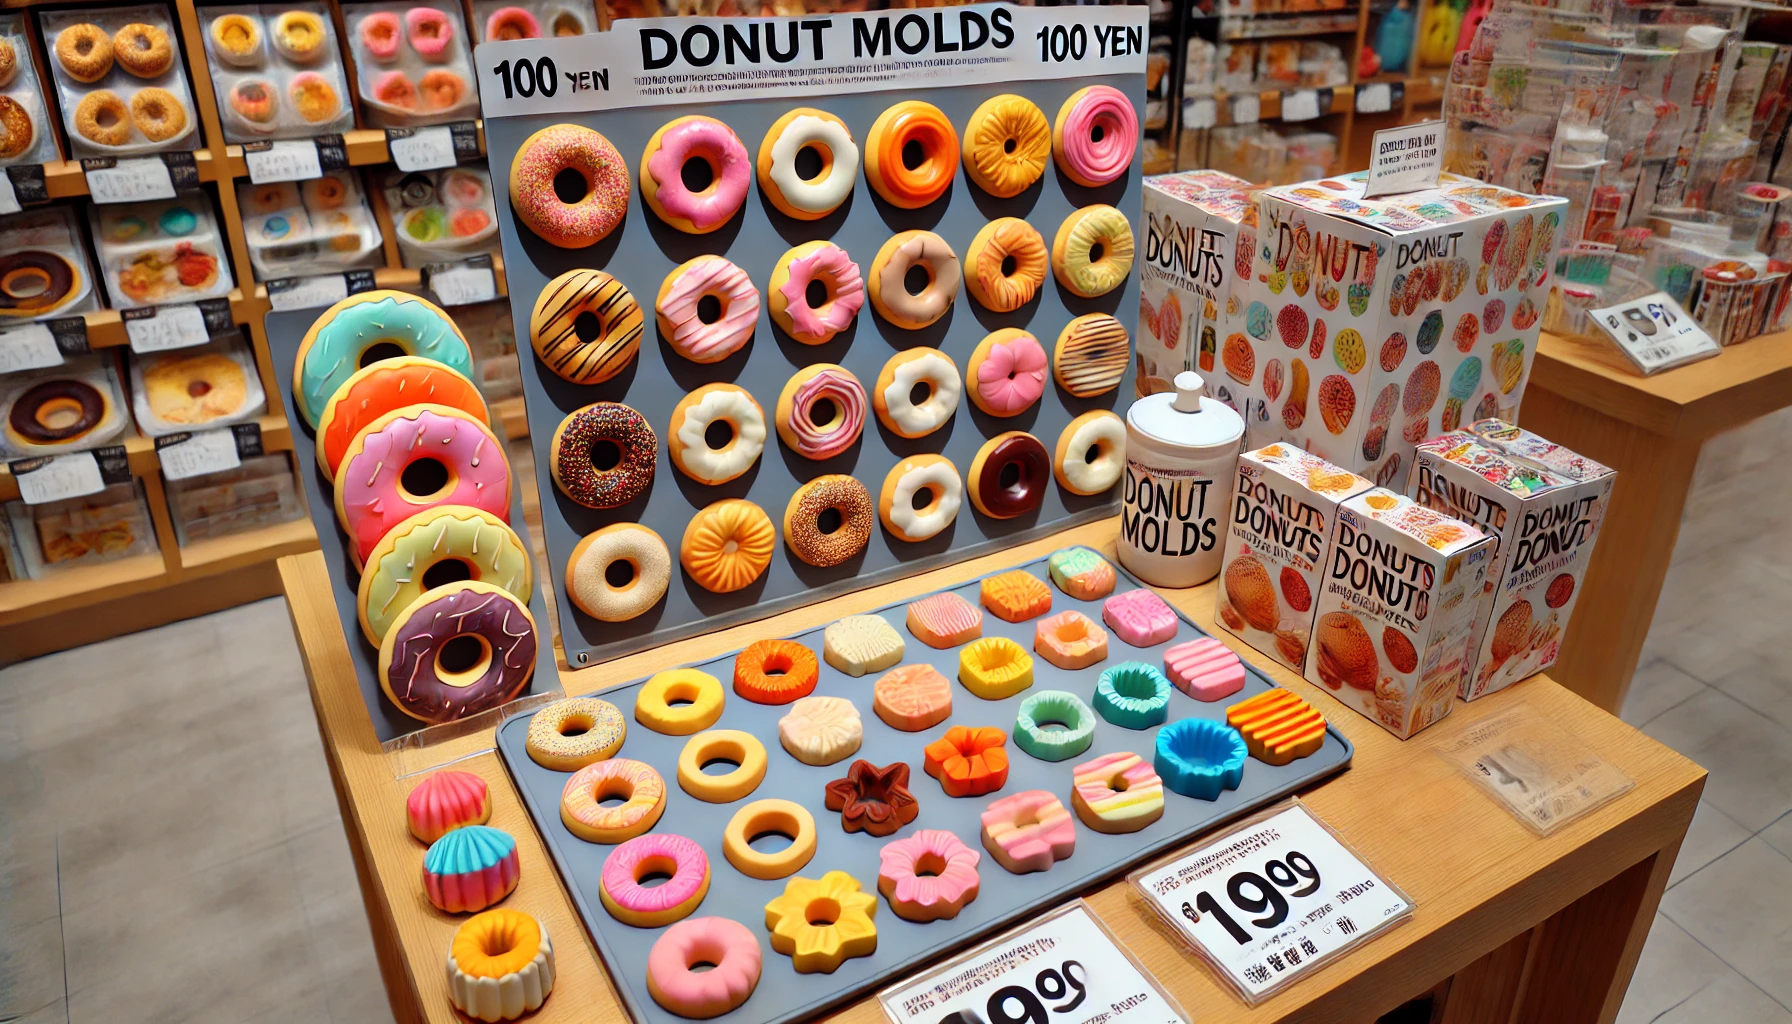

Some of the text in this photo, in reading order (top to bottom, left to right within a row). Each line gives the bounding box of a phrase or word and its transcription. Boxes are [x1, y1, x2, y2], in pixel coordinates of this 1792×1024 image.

[638, 6, 1015, 71] DONUT MOLDS
[1036, 23, 1143, 63] 100 YEN
[493, 56, 558, 99] 100
[564, 67, 609, 94] YEN
[1396, 231, 1464, 270] DONUT
[1124, 465, 1213, 521] DONUT
[1122, 505, 1217, 557] MOLDS
